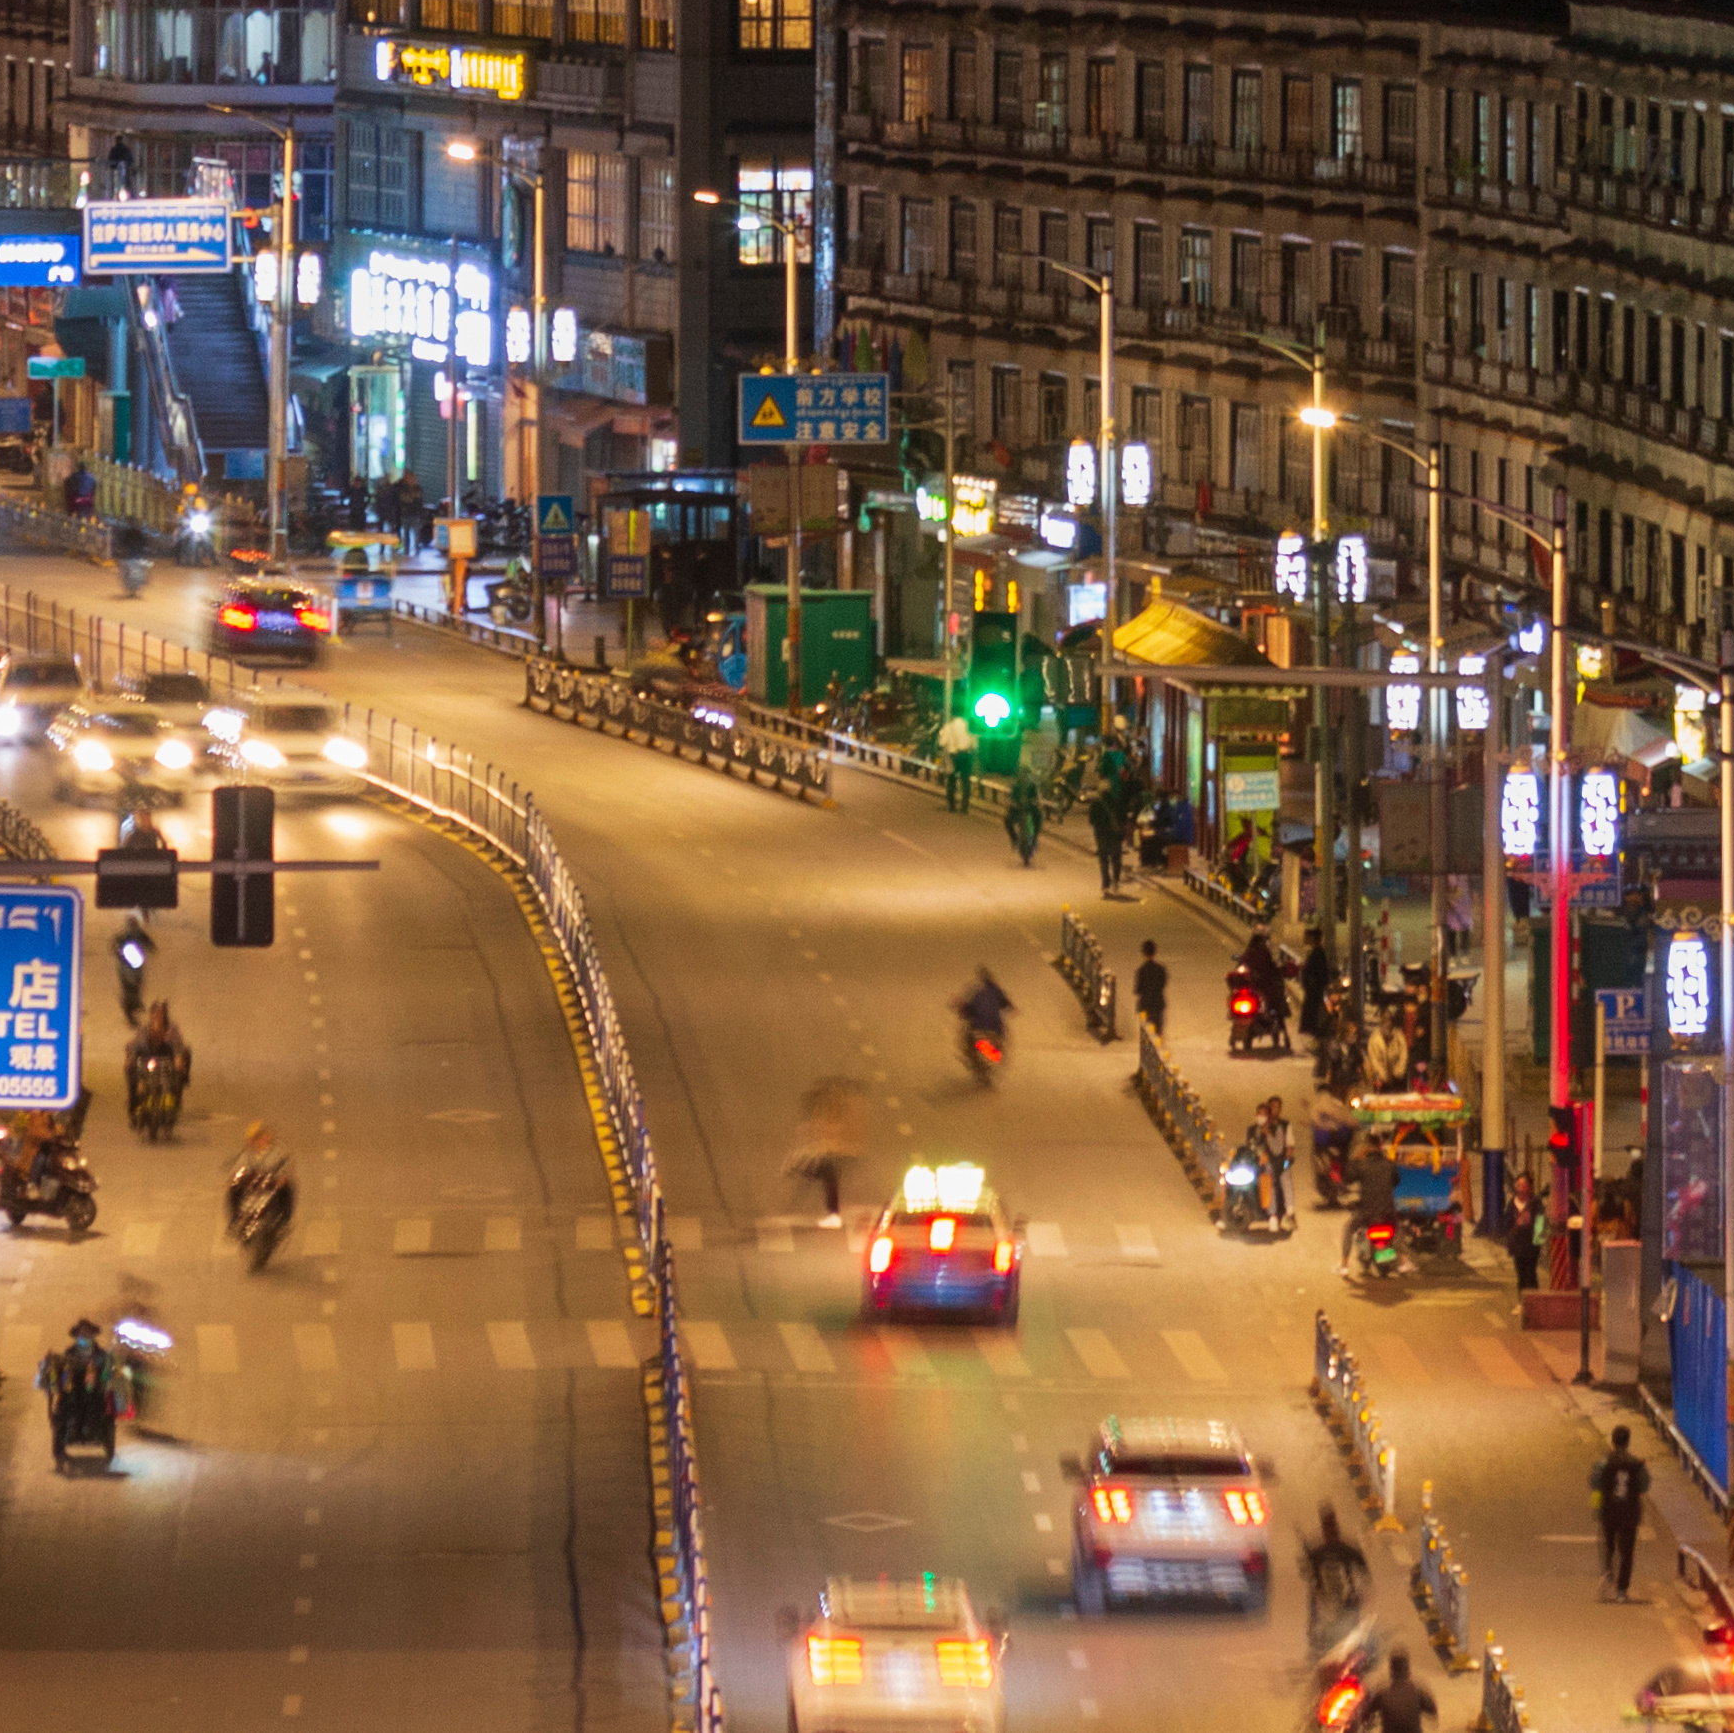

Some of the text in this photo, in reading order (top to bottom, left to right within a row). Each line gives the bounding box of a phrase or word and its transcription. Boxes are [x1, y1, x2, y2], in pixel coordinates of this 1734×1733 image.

[795, 386, 881, 407] 前方学校
[795, 420, 881, 440] 注意安全
[9, 1044, 57, 1071] 观景
